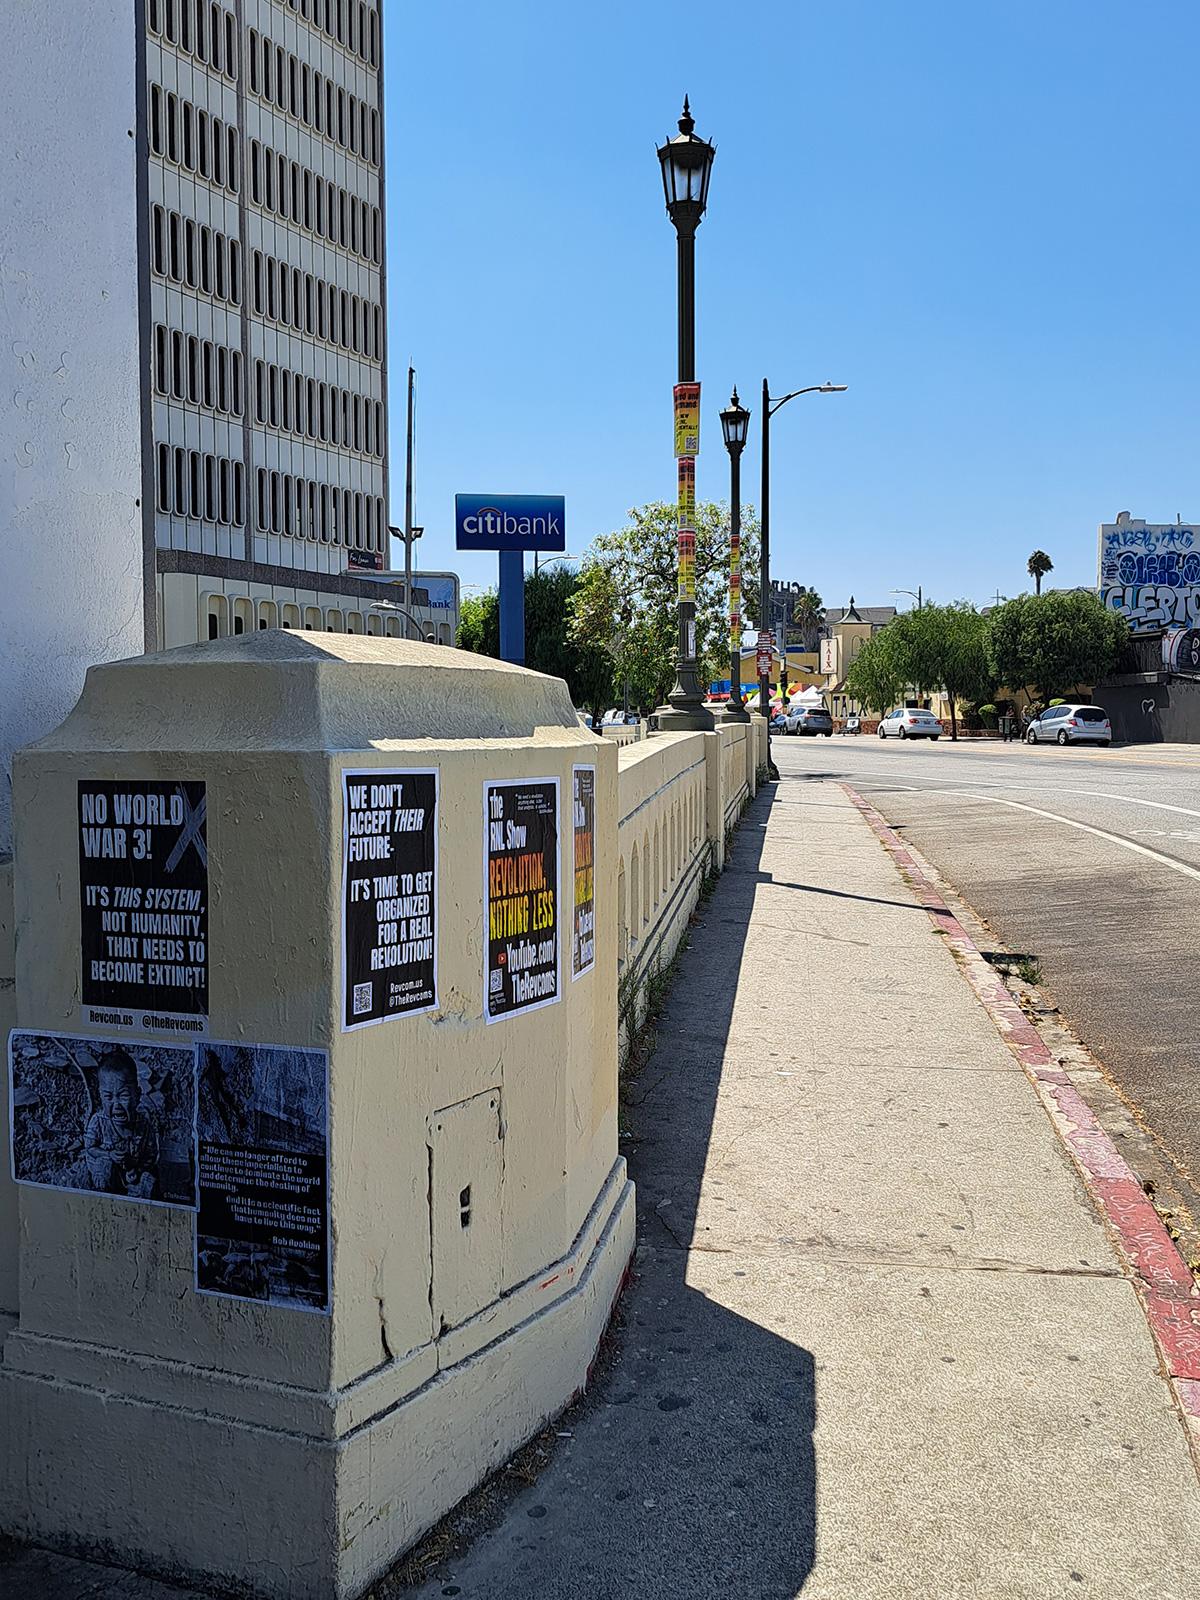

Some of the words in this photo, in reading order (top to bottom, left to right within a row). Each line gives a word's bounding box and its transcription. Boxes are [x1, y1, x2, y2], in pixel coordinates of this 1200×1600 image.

[463, 508, 560, 535] citibank
[82, 794, 107, 824] NO
[113, 794, 184, 826] WORLD
[349, 785, 367, 809] WE
[371, 784, 403, 808] DON'T
[350, 810, 392, 835] ACCEPT
[394, 808, 425, 832] THEIR
[82, 827, 127, 859] WAR
[132, 828, 153, 860] 3!
[490, 820, 505, 852] RNL
[506, 819, 527, 850] Show
[351, 878, 370, 902] IT'S
[373, 875, 398, 899] TIME
[401, 873, 413, 895] TO
[415, 871, 433, 893] GET
[489, 852, 547, 899] REVOLUTION,
[86, 885, 109, 907] IT'S
[113, 886, 142, 909] THIS
[145, 887, 205, 913] SYSTEM,
[376, 894, 430, 922] ORGANIZED
[102, 910, 126, 932] NOT
[131, 912, 205, 938] HUMANITY,
[489, 895, 529, 941] NOTHING
[532, 890, 554, 931] LESS
[378, 922, 398, 946] FOR
[400, 920, 407, 942] A
[409, 916, 433, 940] REAL
[106, 936, 138, 957] THAT
[142, 937, 184, 962] NEEDS
[188, 940, 205, 963] TO
[370, 938, 433, 971] REVOLUTION!
[506, 932, 556, 974] YouTube.com/
[91, 960, 144, 984] BECOME
[148, 963, 205, 988] EXTINCT!
[390, 979, 423, 994] Revcom.us
[511, 970, 556, 1004] TheRevcoms
[389, 989, 433, 1008] @TheRevcoms
[89, 1009, 133, 1026] Revcom.us
[142, 1013, 204, 1032] @TheRevcoms
[244, 1150, 270, 1162] longer
[271, 1154, 298, 1165] afford
[299, 1157, 308, 1167] to
[293, 1165, 303, 1175] to
[234, 1166, 244, 1176] to
[282, 1173, 295, 1182] the
[296, 1175, 321, 1186] world
[301, 1184, 310, 1193] of
[254, 1216, 263, 1225] to
[303, 1205, 321, 1216] fact
[307, 1216, 321, 1225] not
[272, 1235, 288, 1246] Bob
